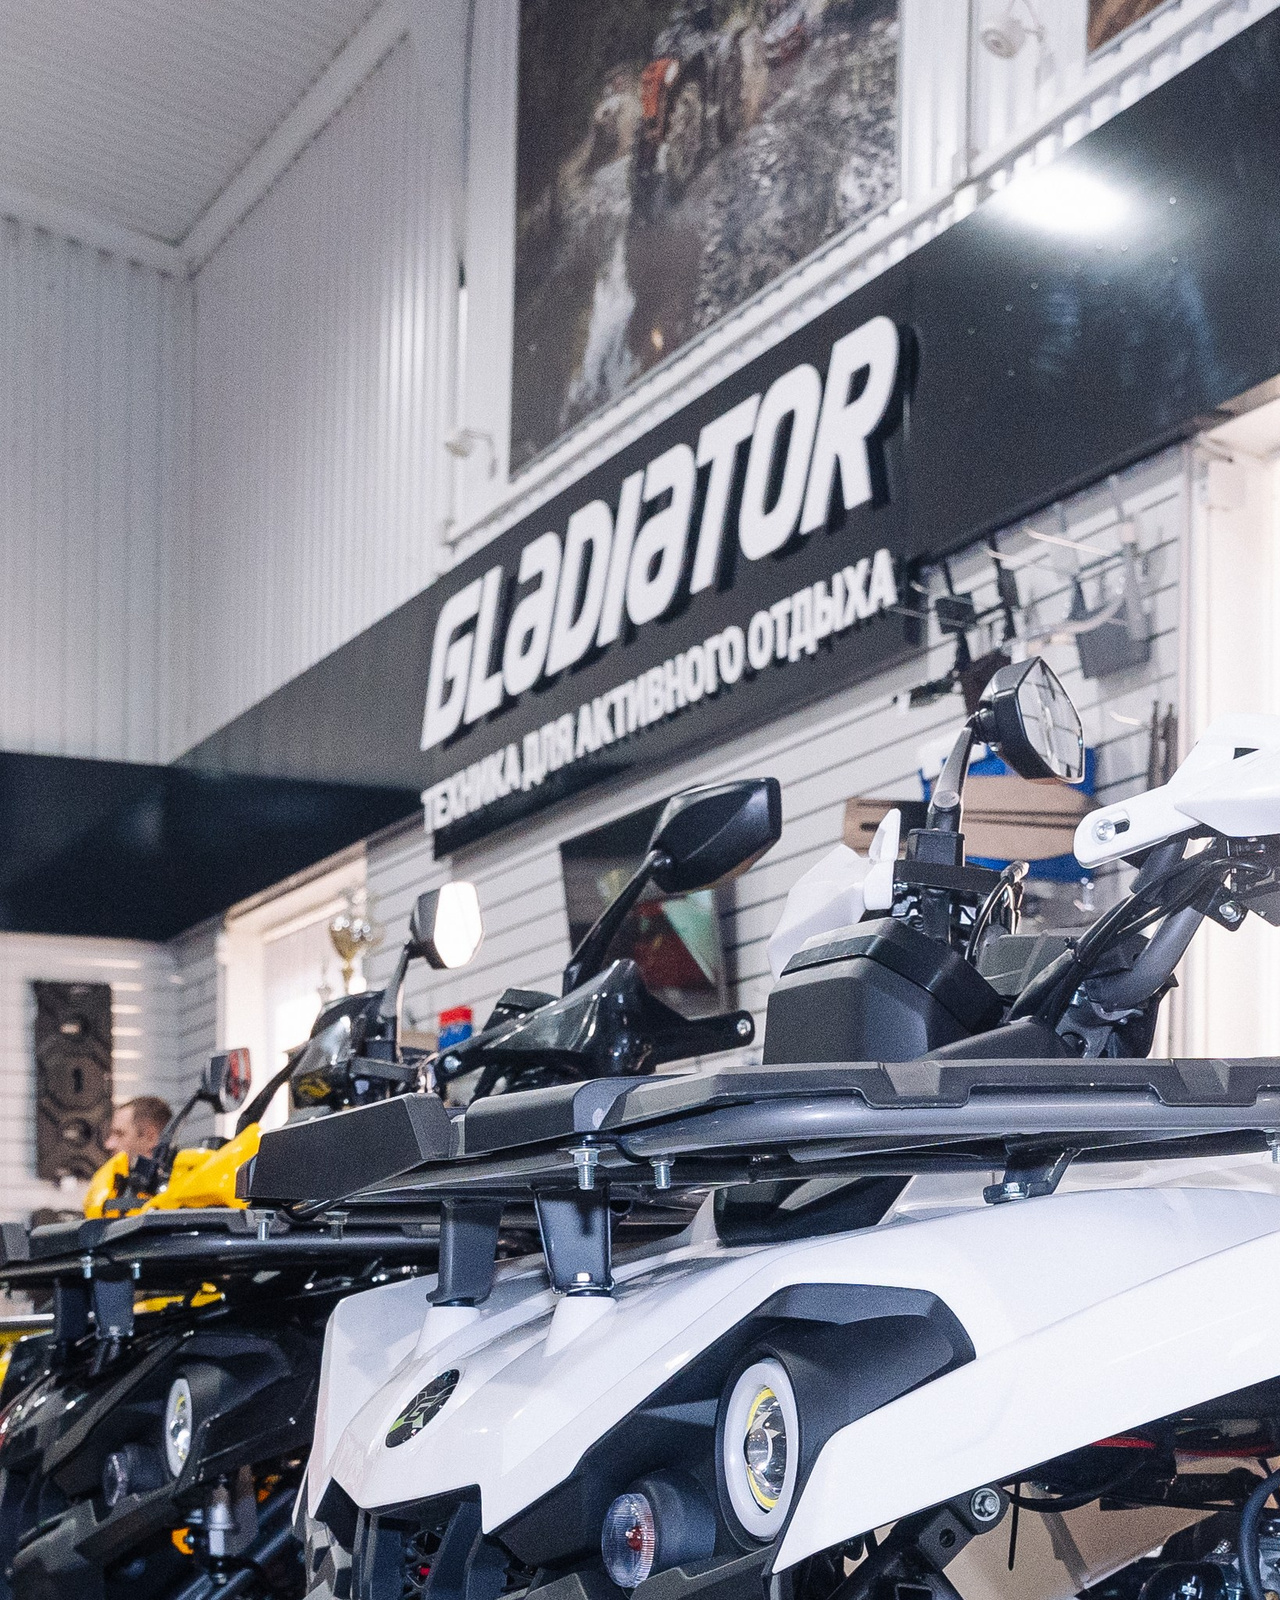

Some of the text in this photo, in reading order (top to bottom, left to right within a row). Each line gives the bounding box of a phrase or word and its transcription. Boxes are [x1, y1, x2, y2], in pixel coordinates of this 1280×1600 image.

[421, 548, 899, 833] ТЕХНИКА ДЛЯ АКТИВНОГО ОТДЫХА
